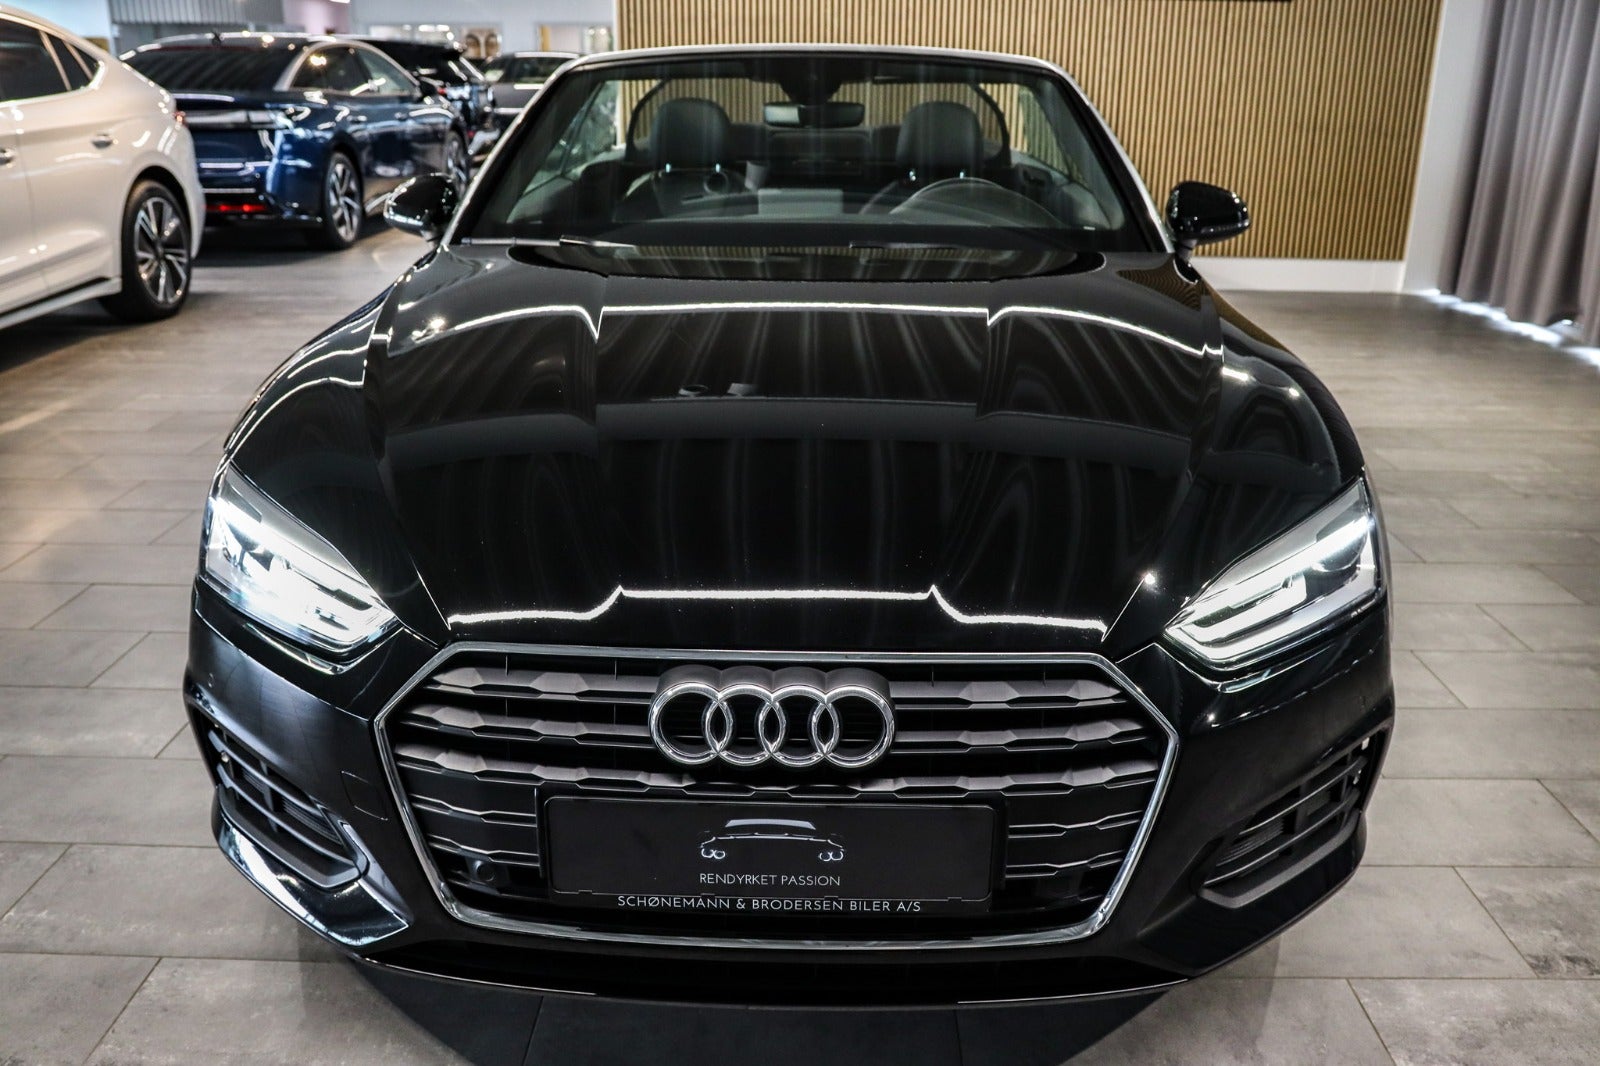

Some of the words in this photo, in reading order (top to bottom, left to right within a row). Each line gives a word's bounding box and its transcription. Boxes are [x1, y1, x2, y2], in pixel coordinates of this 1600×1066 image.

[699, 873, 777, 886] RENDYRKET
[781, 875, 841, 887] PASSION
[617, 895, 730, 909] SCHØNEMANN
[736, 899, 746, 910] &
[752, 899, 843, 911] BRODERSEN
[850, 900, 890, 912] BILER
[896, 901, 921, 912] A/S
